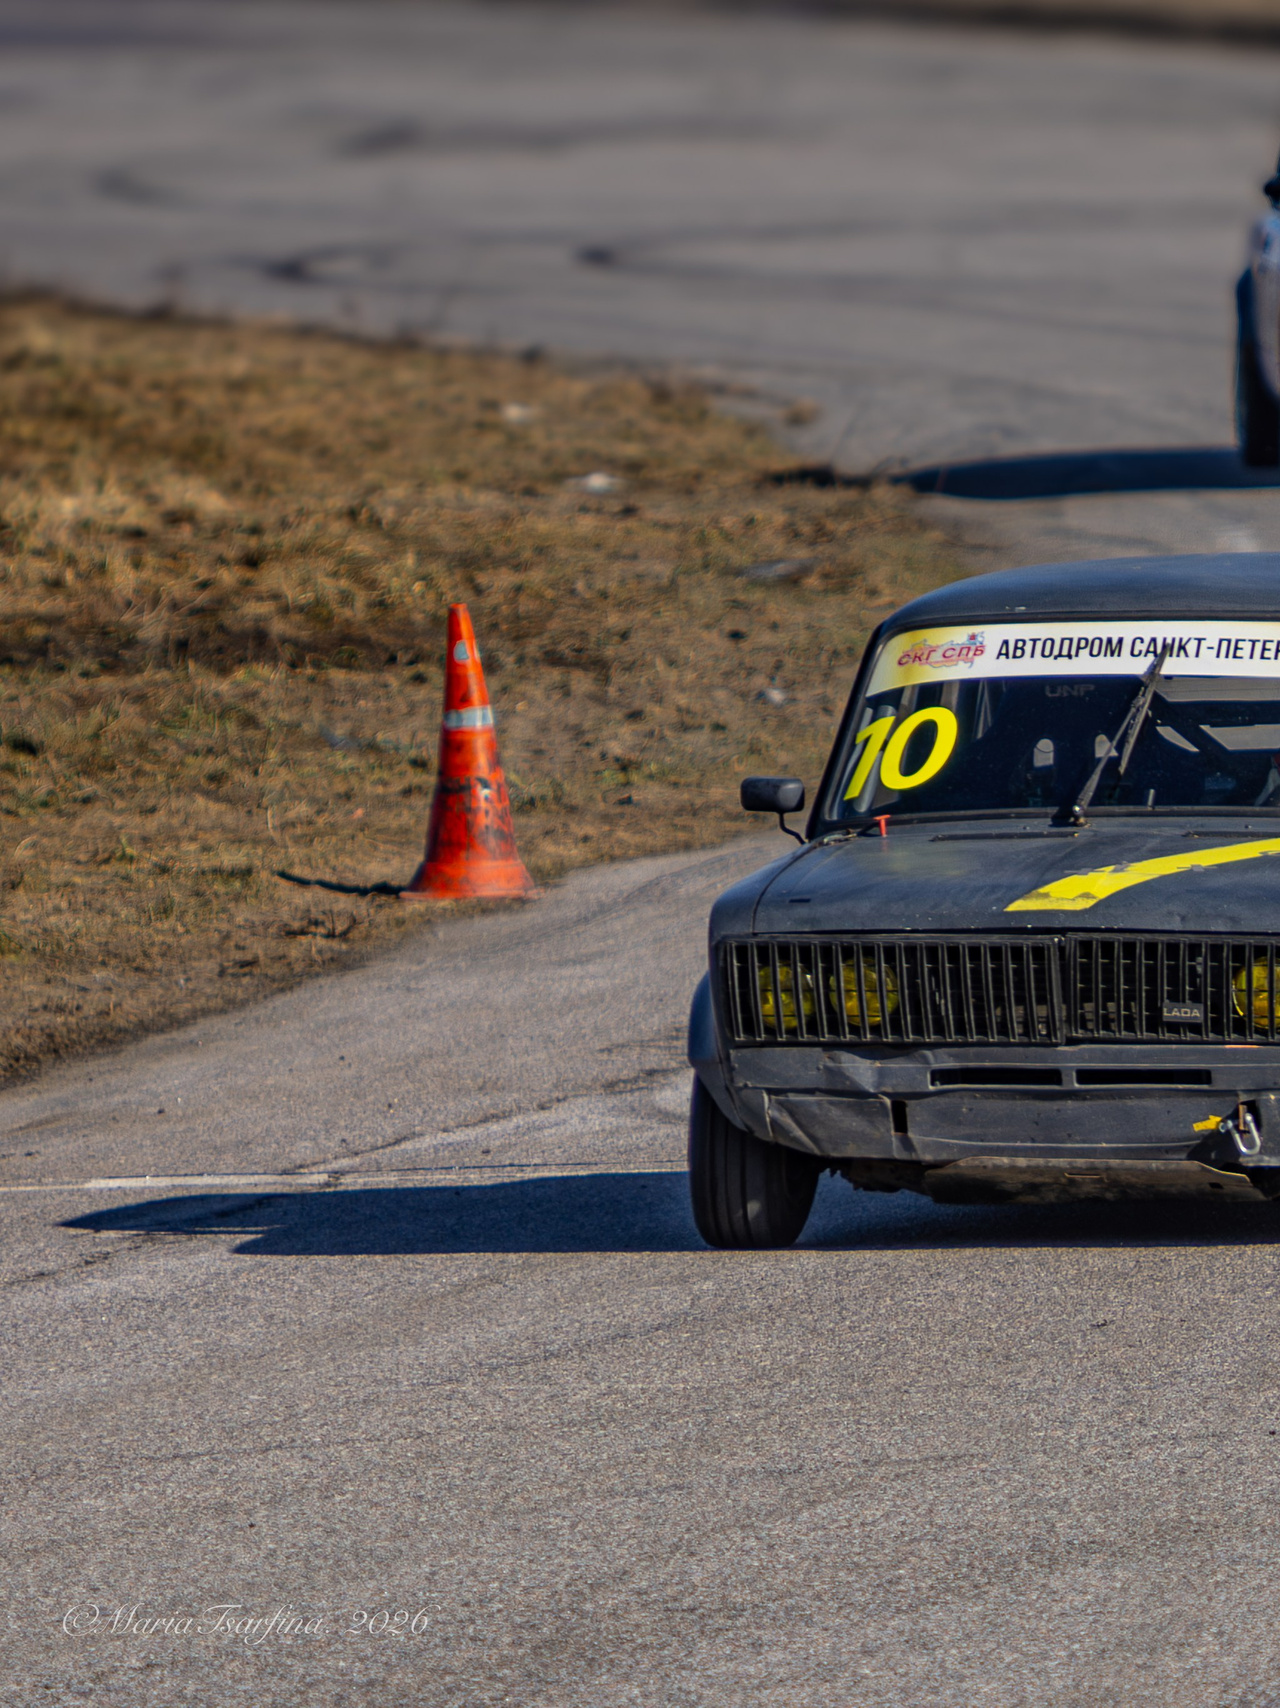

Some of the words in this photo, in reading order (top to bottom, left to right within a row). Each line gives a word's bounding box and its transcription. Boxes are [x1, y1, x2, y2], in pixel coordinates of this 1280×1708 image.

[897, 649, 937, 666] СКГ
[942, 645, 986, 659] СПБ
[995, 636, 1125, 661] АВТОДРОМ
[843, 706, 958, 801] 10
[1162, 1007, 1201, 1017] LADA
